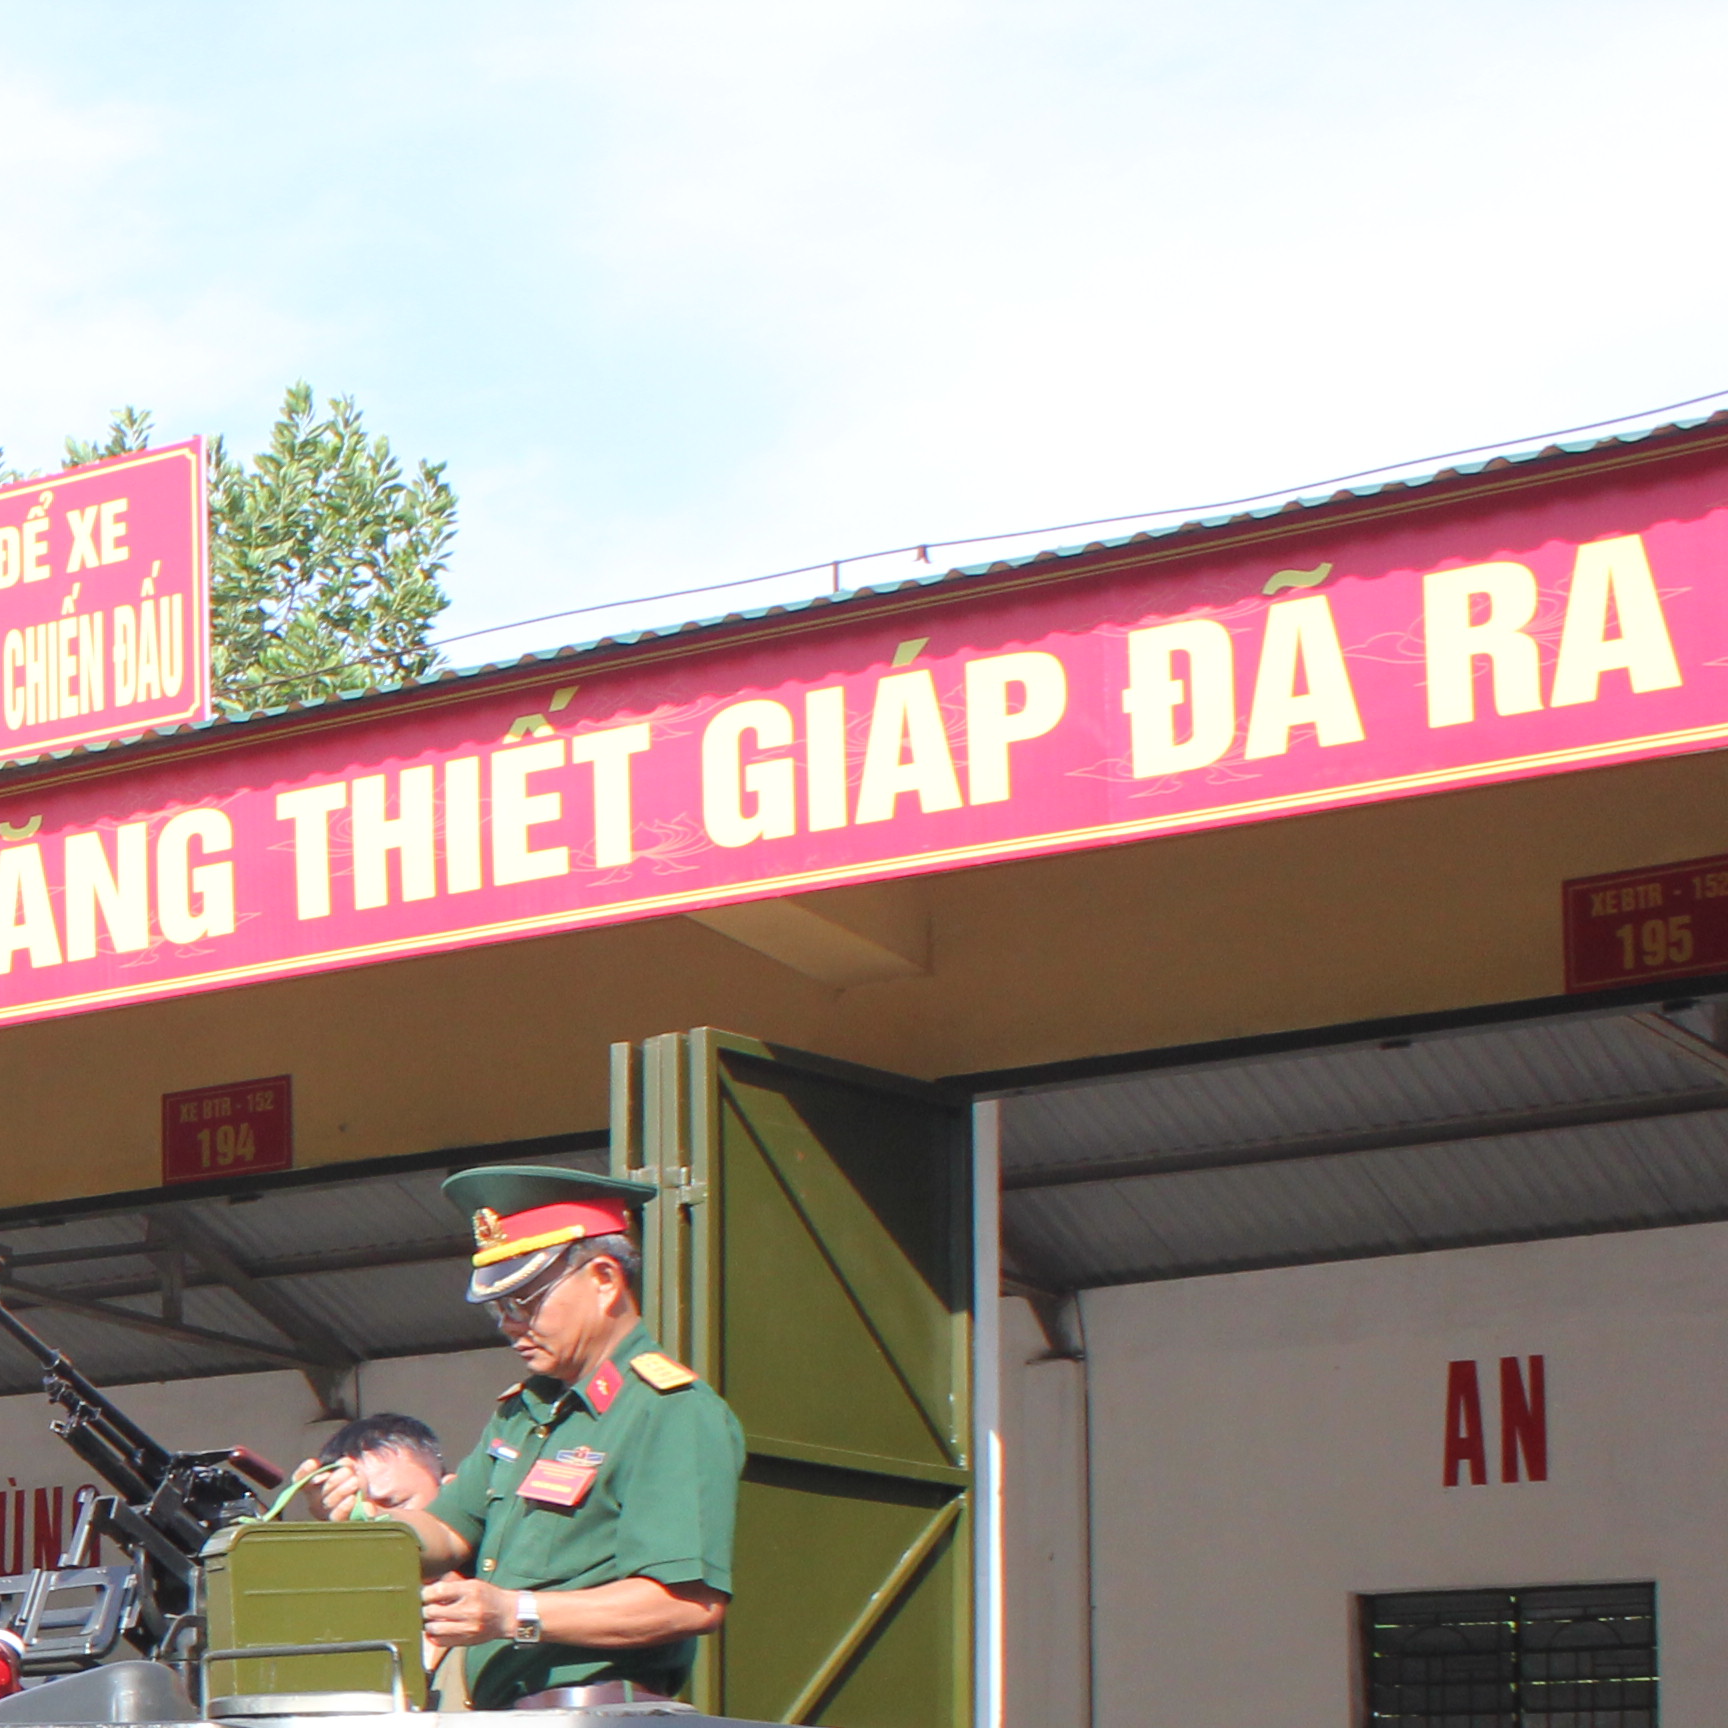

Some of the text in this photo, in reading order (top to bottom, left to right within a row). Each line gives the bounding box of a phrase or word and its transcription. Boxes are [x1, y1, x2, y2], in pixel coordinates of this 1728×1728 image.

[66, 498, 129, 573] XE
[3, 582, 104, 730] CHIẾN
[113, 560, 184, 708] ĐẤU
[275, 686, 652, 921] THIẾT
[701, 637, 1067, 848] GIÁP
[1122, 562, 1365, 779] ĐÃ
[1423, 534, 1682, 729] RA
[1615, 915, 1694, 970] 195
[247, 1091, 274, 1113] 152
[197, 1122, 255, 1168] 194
[1443, 1354, 1548, 1487] AN
